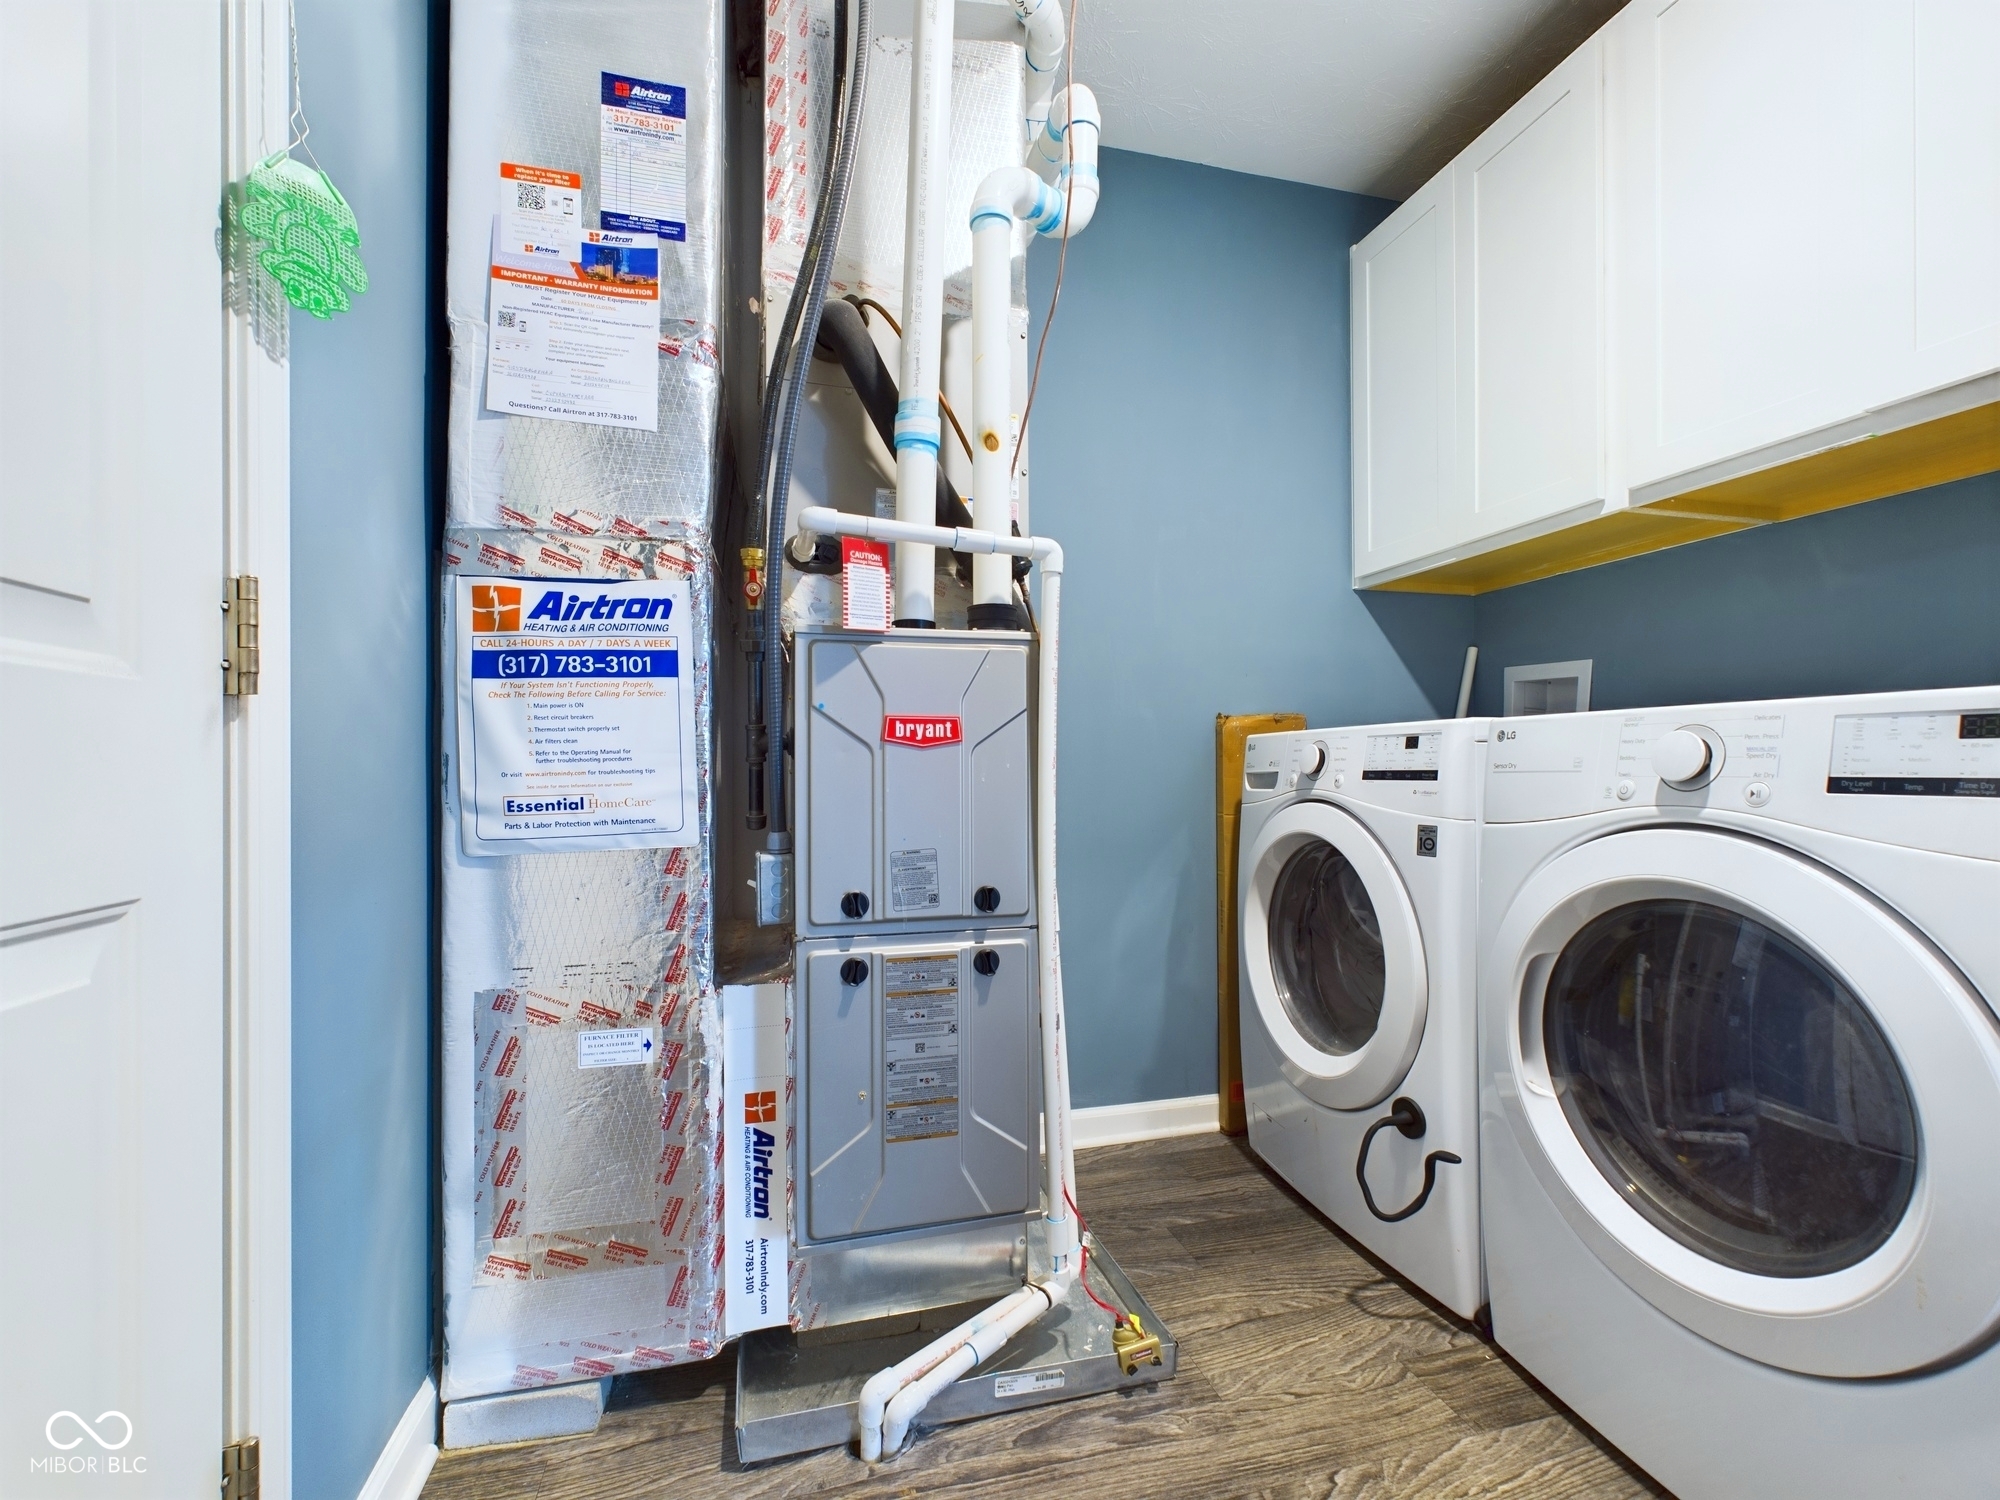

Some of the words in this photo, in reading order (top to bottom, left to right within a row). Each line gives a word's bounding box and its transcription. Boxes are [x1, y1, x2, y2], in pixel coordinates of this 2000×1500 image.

[631, 86, 672, 102] Airtron
[614, 114, 675, 132] 317-783-3101
[630, 110, 660, 121] Emergency
[614, 126, 674, 142] www.airtronindy.com
[514, 173, 538, 182] replace
[554, 178, 570, 186] filter
[602, 234, 633, 244] Airtron
[534, 246, 560, 254] Airtron
[500, 269, 548, 282] IMPORTANT
[554, 278, 598, 290] WARRANTY
[600, 285, 653, 296] INFORMATION
[524, 284, 542, 292] MUST
[544, 287, 570, 296] Register
[608, 296, 639, 305] Equipment
[532, 302, 575, 312] MANUFACTURER
[508, 400, 547, 412] Questions?
[562, 408, 587, 416] Airtron
[596, 411, 638, 421] 317-783-3101
[546, 533, 563, 544] COLD
[564, 541, 590, 554] WEATHER
[481, 545, 525, 566] VentureTape
[538, 556, 557, 568] 1581A
[540, 550, 582, 570] VentureTape
[850, 550, 882, 562] CAUTION:
[477, 557, 500, 570] 181B-FX
[527, 590, 673, 621] Airtron
[524, 622, 568, 633] HEATING
[569, 624, 576, 632] &
[578, 624, 595, 632] AIR
[598, 623, 669, 632] CONDITIONING
[480, 640, 503, 648] CALL
[506, 639, 554, 647] 24-HOURS
[589, 639, 594, 648] /
[644, 640, 671, 648] WEEK
[498, 653, 549, 677] (317)
[555, 656, 651, 673] 783-3101
[527, 682, 554, 690] System
[575, 681, 620, 689] Functioning
[528, 691, 564, 699] Following
[594, 690, 620, 698] Calling
[895, 720, 952, 740] bryant
[1746, 752, 1764, 760] Speed
[1766, 752, 1777, 760] Dry
[1980, 782, 1996, 791] Dry
[506, 797, 584, 812] Essential
[555, 820, 591, 828] Protection
[611, 818, 656, 826] Maintenance
[480, 1057, 489, 1072] COLD
[486, 1030, 500, 1057] WEATHER
[498, 1036, 520, 1076] VentureTape
[506, 1060, 517, 1078] 1581A
[753, 1127, 776, 1220] Airtron
[554, 1234, 570, 1242] COLD
[571, 1238, 597, 1249] WEATHER
[488, 1258, 531, 1272] VentureTape
[547, 1251, 589, 1266] VentureTape
[482, 1270, 505, 1279] 181B-FX
[745, 1240, 754, 1294] 317-783-3101
[760, 1238, 770, 1315] AirtronIndy.com
